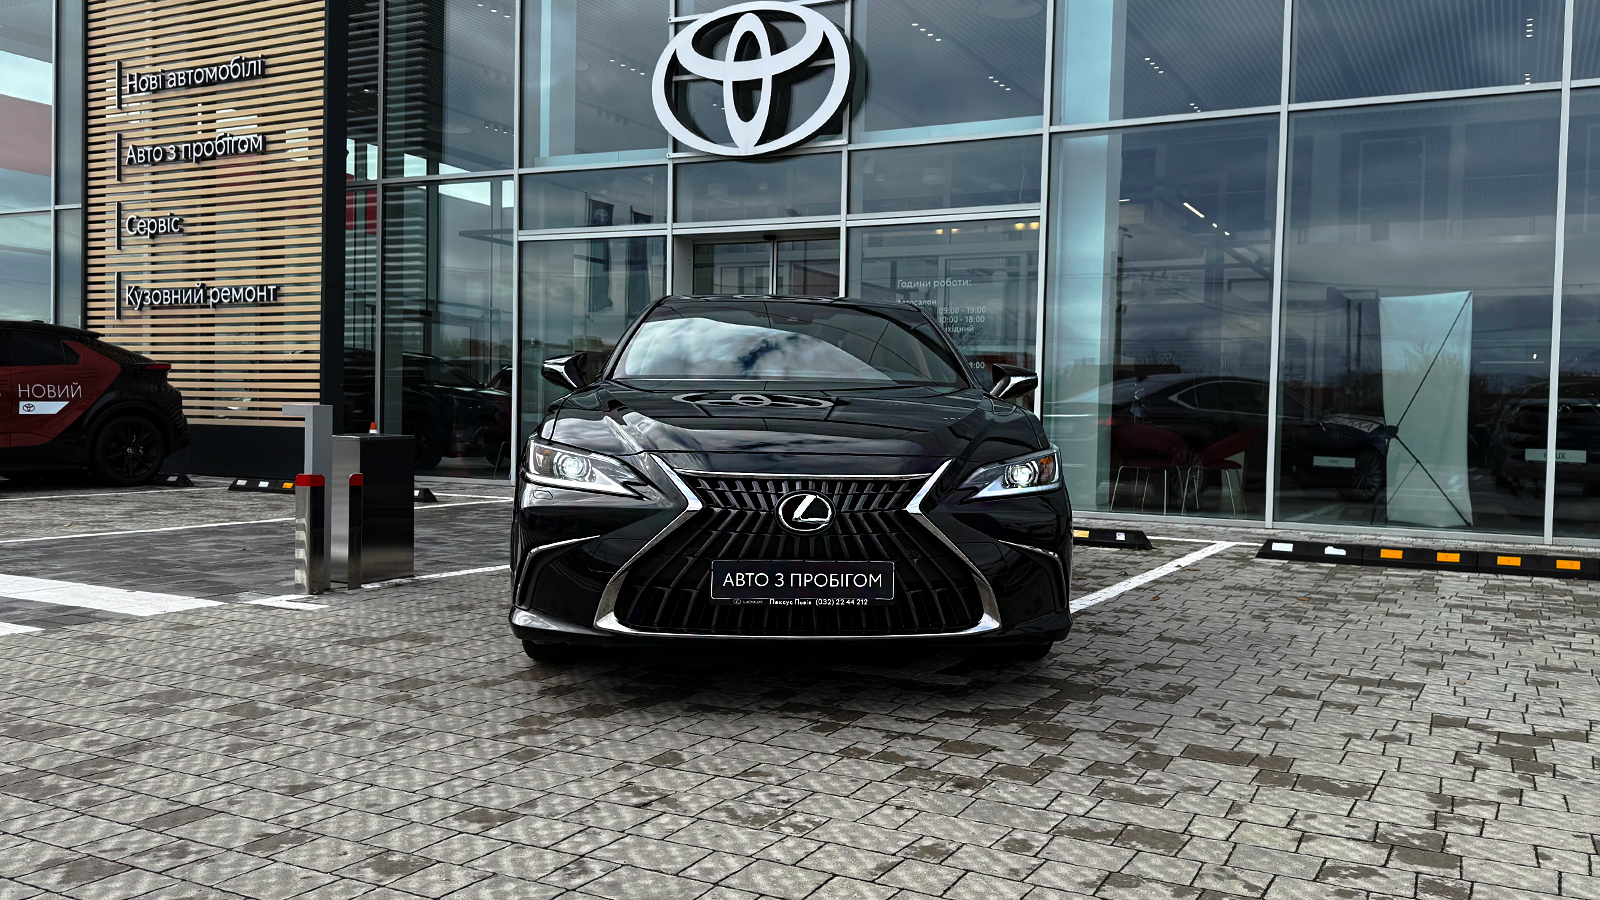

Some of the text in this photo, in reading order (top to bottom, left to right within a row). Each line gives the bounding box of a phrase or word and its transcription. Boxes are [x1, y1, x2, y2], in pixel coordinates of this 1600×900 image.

[126, 54, 263, 94] Нові автомобілі
[126, 133, 264, 165] Авто з пробігом
[125, 212, 181, 239] Сервіс
[897, 277, 972, 289] Години роботи:
[125, 283, 278, 311] Кузовний ремонт
[18, 381, 82, 399] НОВИЙ
[722, 572, 882, 588] АВТО З ПРОБІГОМ
